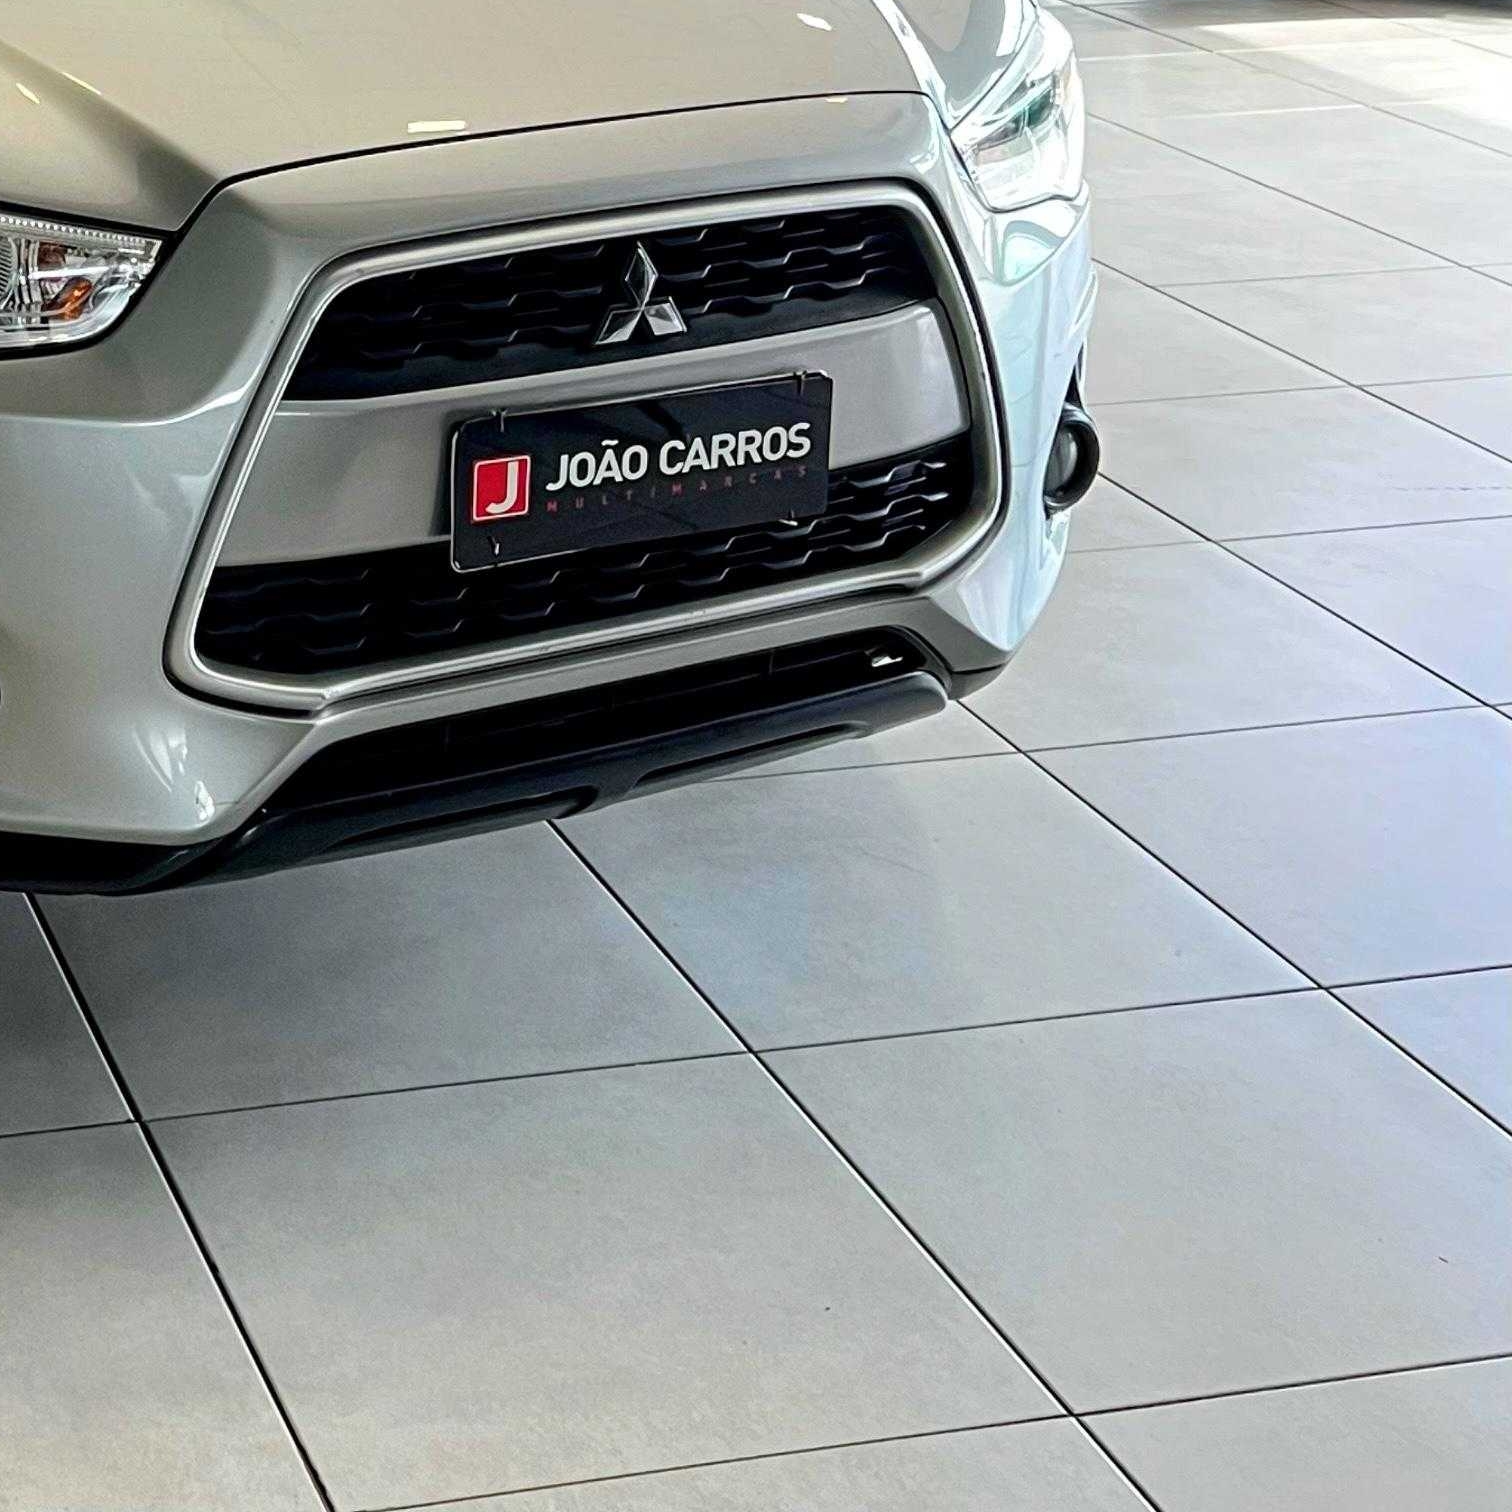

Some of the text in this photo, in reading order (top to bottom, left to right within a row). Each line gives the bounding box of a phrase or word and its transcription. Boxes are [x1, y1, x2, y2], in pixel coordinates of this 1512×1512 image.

[545, 422, 812, 492] JOÃO CARROS
[484, 461, 519, 514] J
[545, 465, 808, 513] MULTIMARCAS
